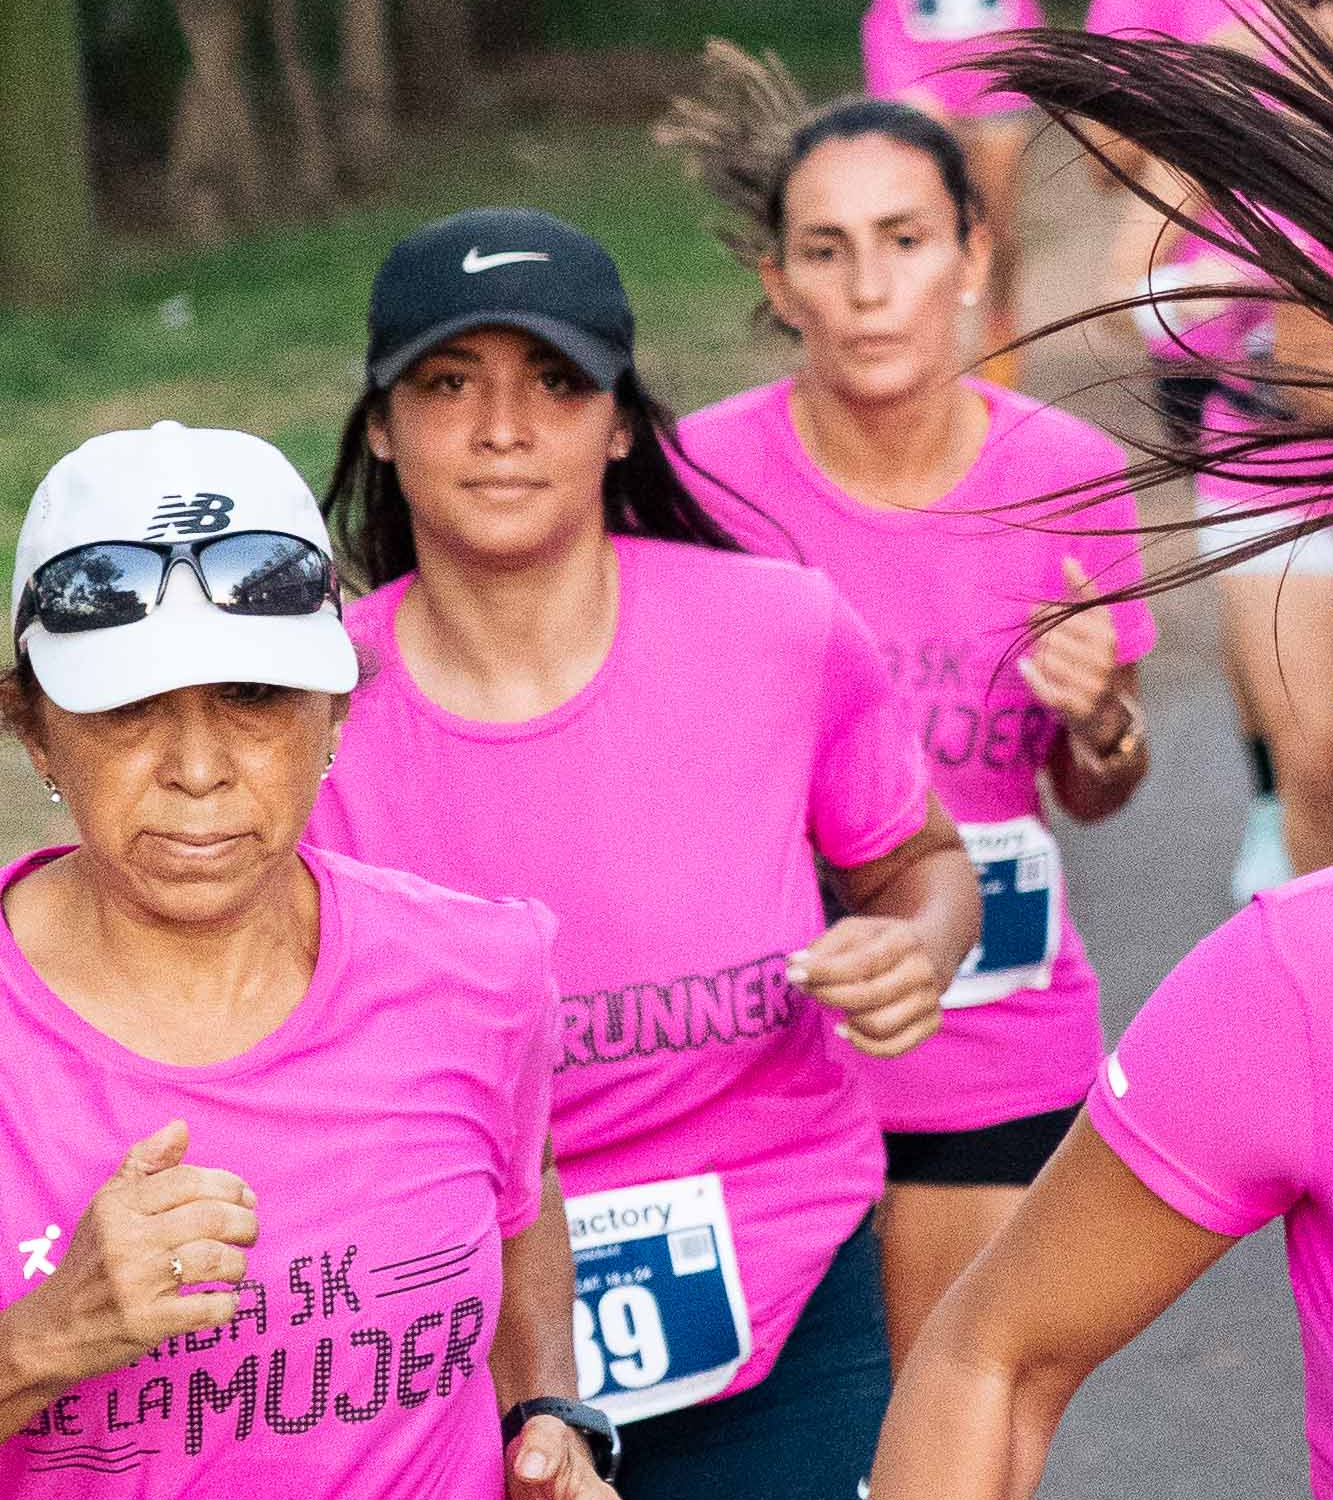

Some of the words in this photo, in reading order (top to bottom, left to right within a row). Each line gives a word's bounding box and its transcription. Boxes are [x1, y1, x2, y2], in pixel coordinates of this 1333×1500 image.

[289, 1244, 360, 1326] 5K
[107, 1376, 173, 1433] LA
[185, 1296, 485, 1456] MUJER
